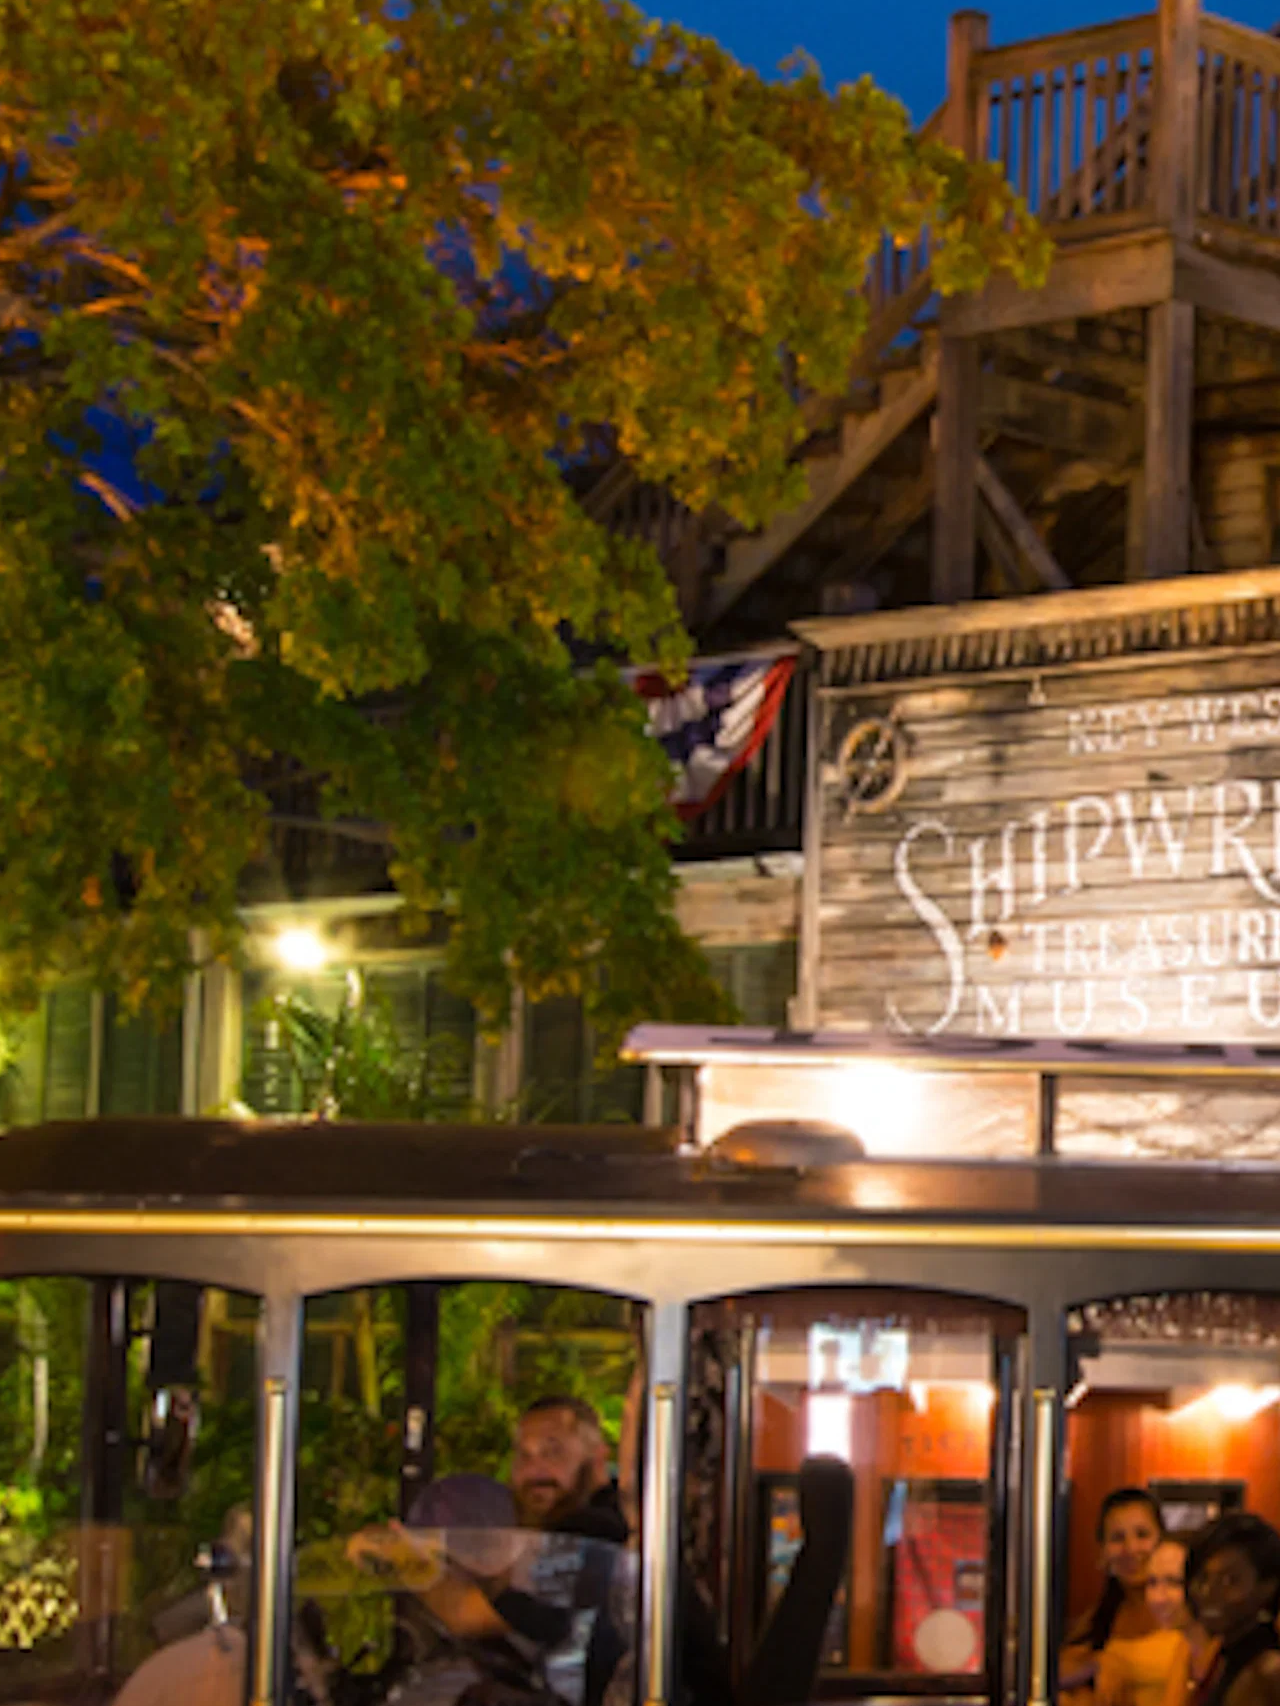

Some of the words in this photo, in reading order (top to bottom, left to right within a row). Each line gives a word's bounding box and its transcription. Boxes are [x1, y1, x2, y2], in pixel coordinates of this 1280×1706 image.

[1067, 702, 1170, 755] KEY
[885, 780, 1280, 1035] SHIPWR
[975, 971, 1280, 1035] MUSEU
